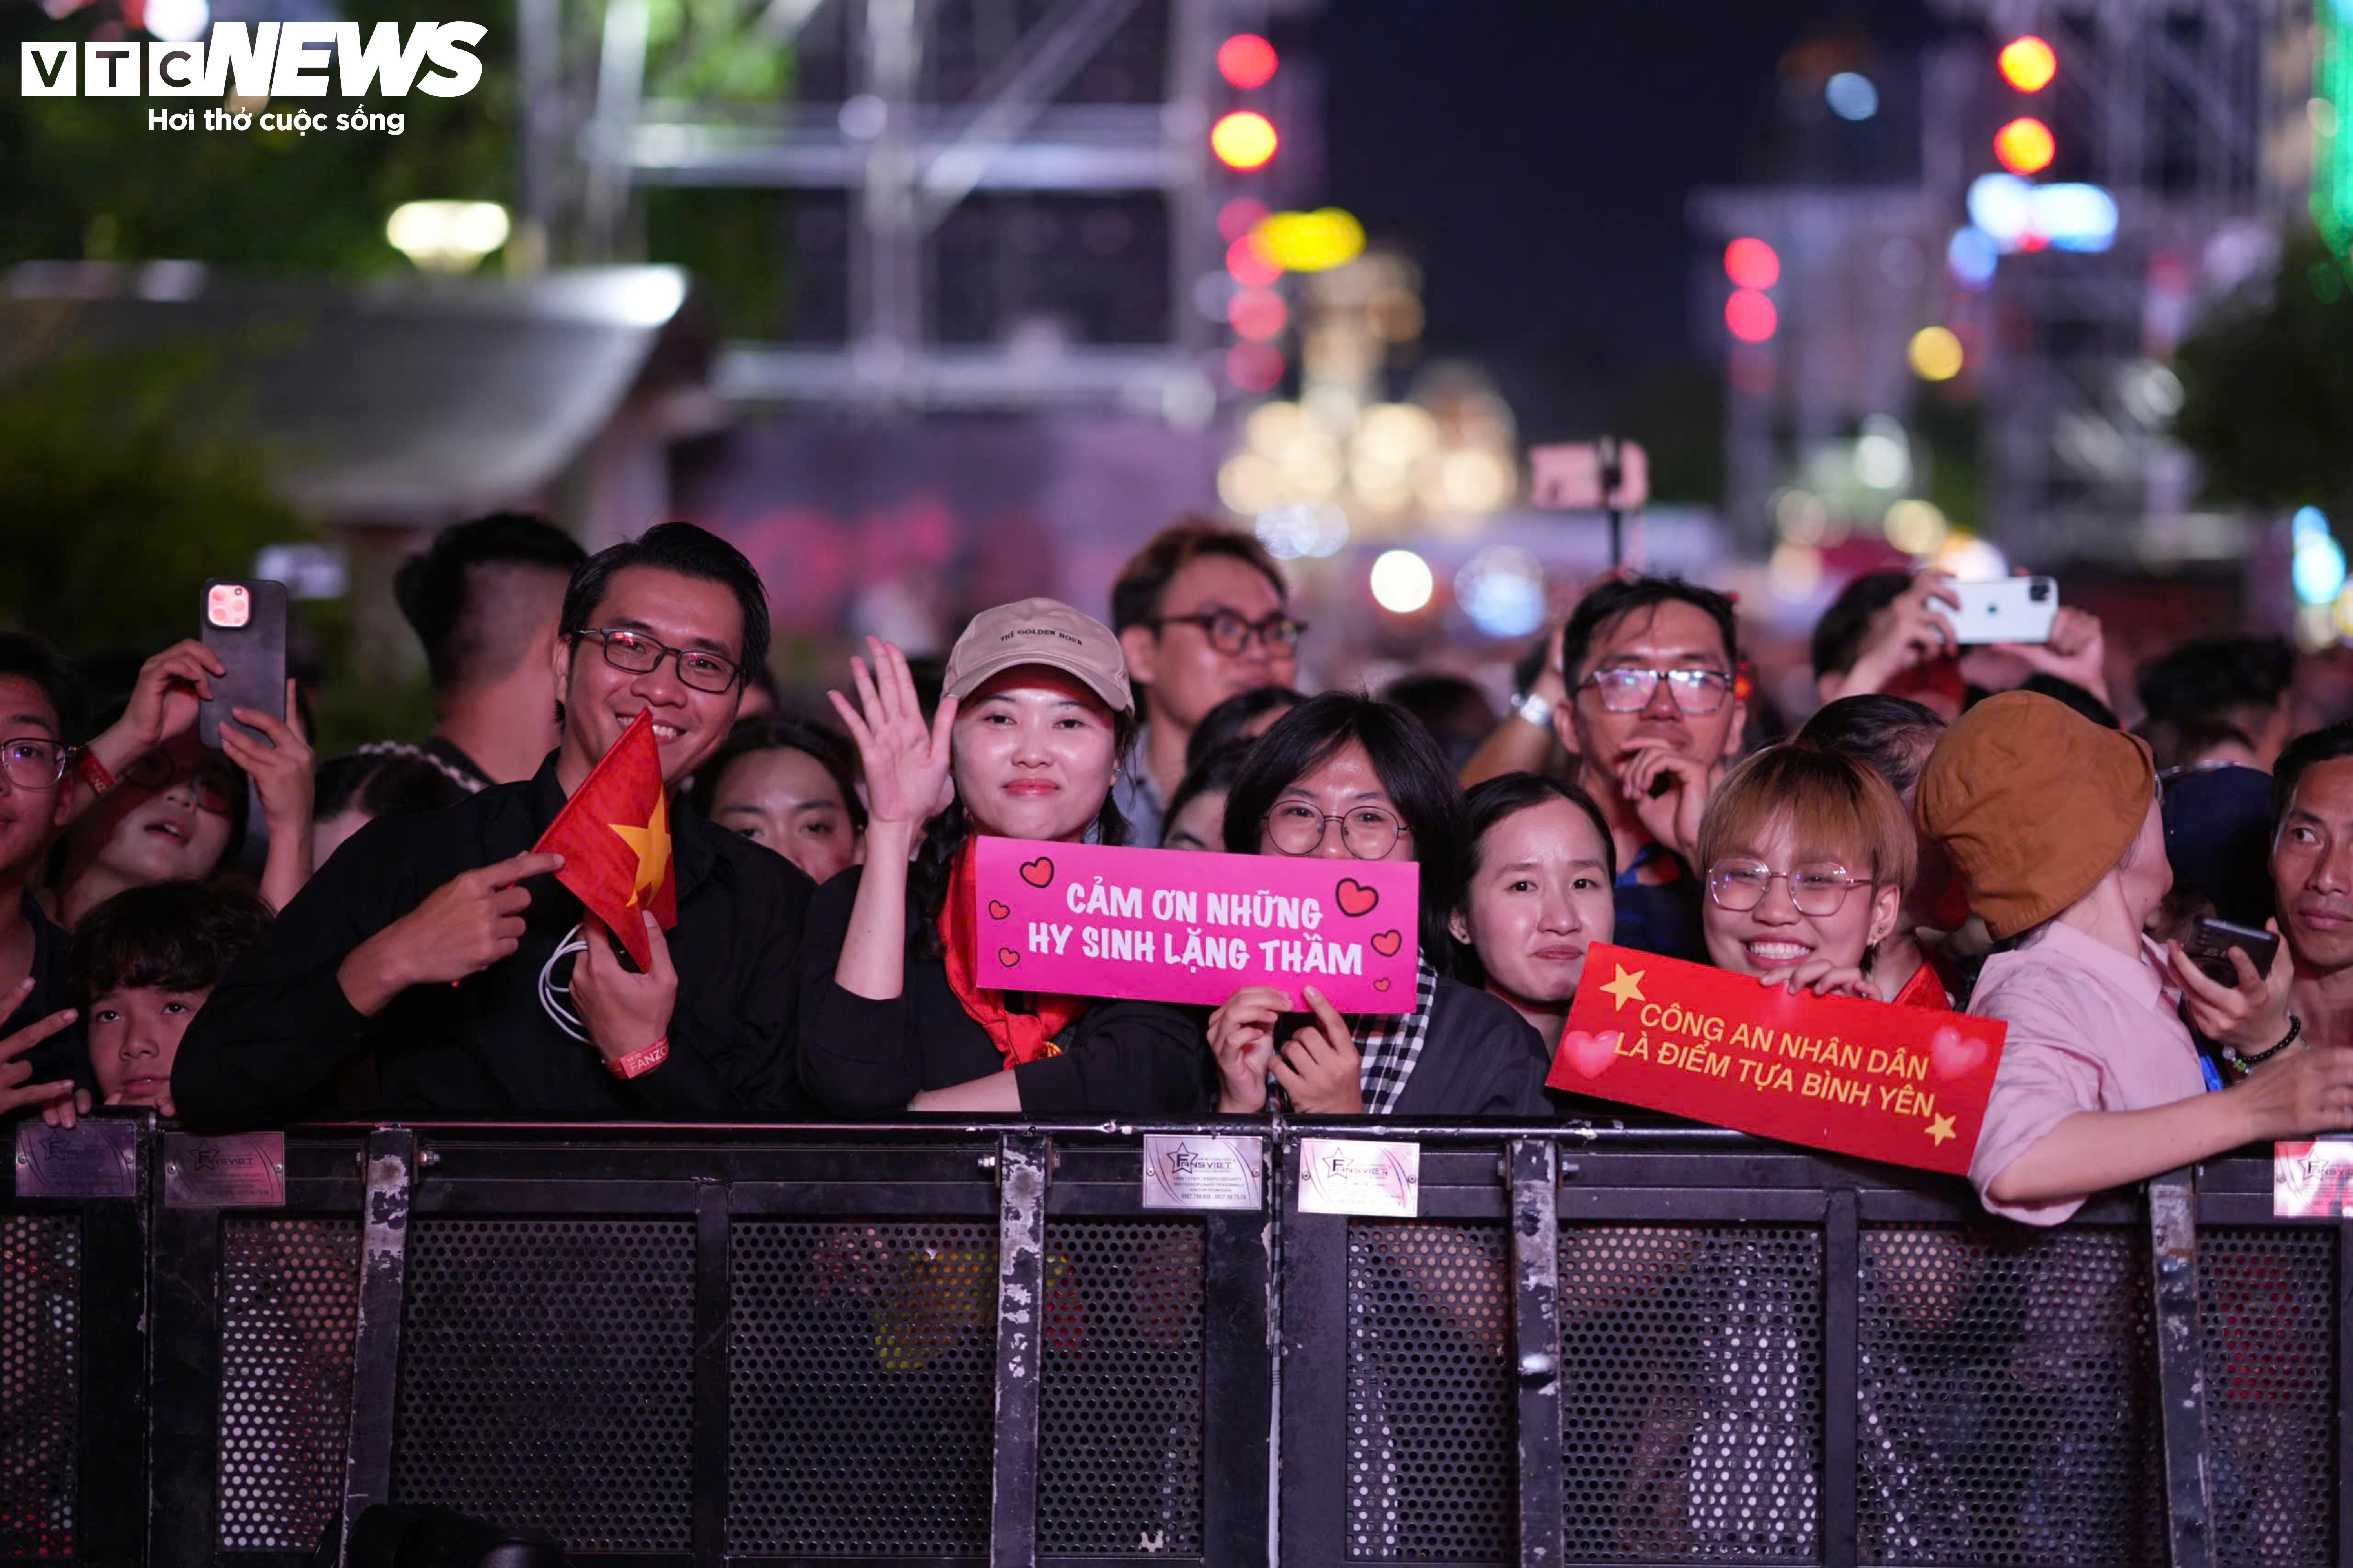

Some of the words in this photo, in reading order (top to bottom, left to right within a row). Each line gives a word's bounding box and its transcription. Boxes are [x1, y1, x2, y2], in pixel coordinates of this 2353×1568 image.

[1000, 631, 1015, 642] THE
[1059, 633, 1082, 646] HOUR
[1066, 876, 1142, 919] CẢM
[1152, 890, 1197, 923] ƠN
[1207, 890, 1323, 930] NHỮNG
[1029, 922, 1073, 955] HY
[1082, 926, 1155, 962] SINH
[1164, 928, 1250, 973] LẶNG
[1258, 933, 1362, 976] THẦM
[1640, 1002, 1724, 1042] CÔNG
[1729, 1023, 1774, 1052] AN
[1779, 1033, 1862, 1069] NHÂN
[1867, 1047, 1928, 1080] DÂN
[1614, 1031, 1648, 1060] LÀ
[1657, 1040, 1731, 1078] ĐIỂM
[1738, 1059, 1793, 1092] TỰA
[1801, 1070, 1871, 1106] BÌNH
[1880, 1084, 1935, 1117] YÊN
[1177, 1154, 1232, 1168] FANSVIET
